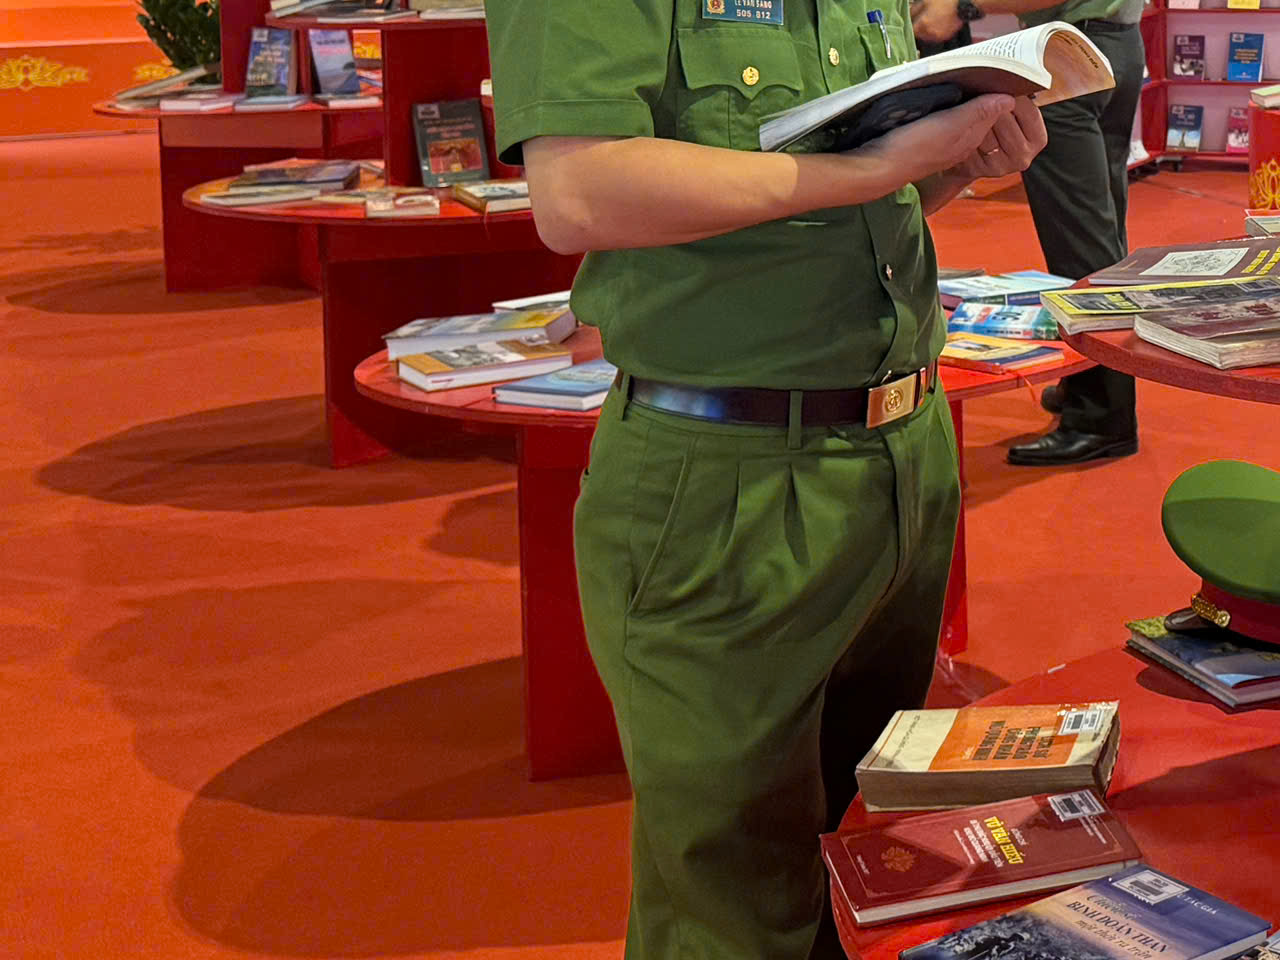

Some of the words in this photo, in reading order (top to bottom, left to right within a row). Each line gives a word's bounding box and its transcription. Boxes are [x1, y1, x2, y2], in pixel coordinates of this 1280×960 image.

[1066, 900, 1098, 921] BINH
[1097, 911, 1132, 936] ĐOÀN
[1132, 930, 1169, 953] THAN
